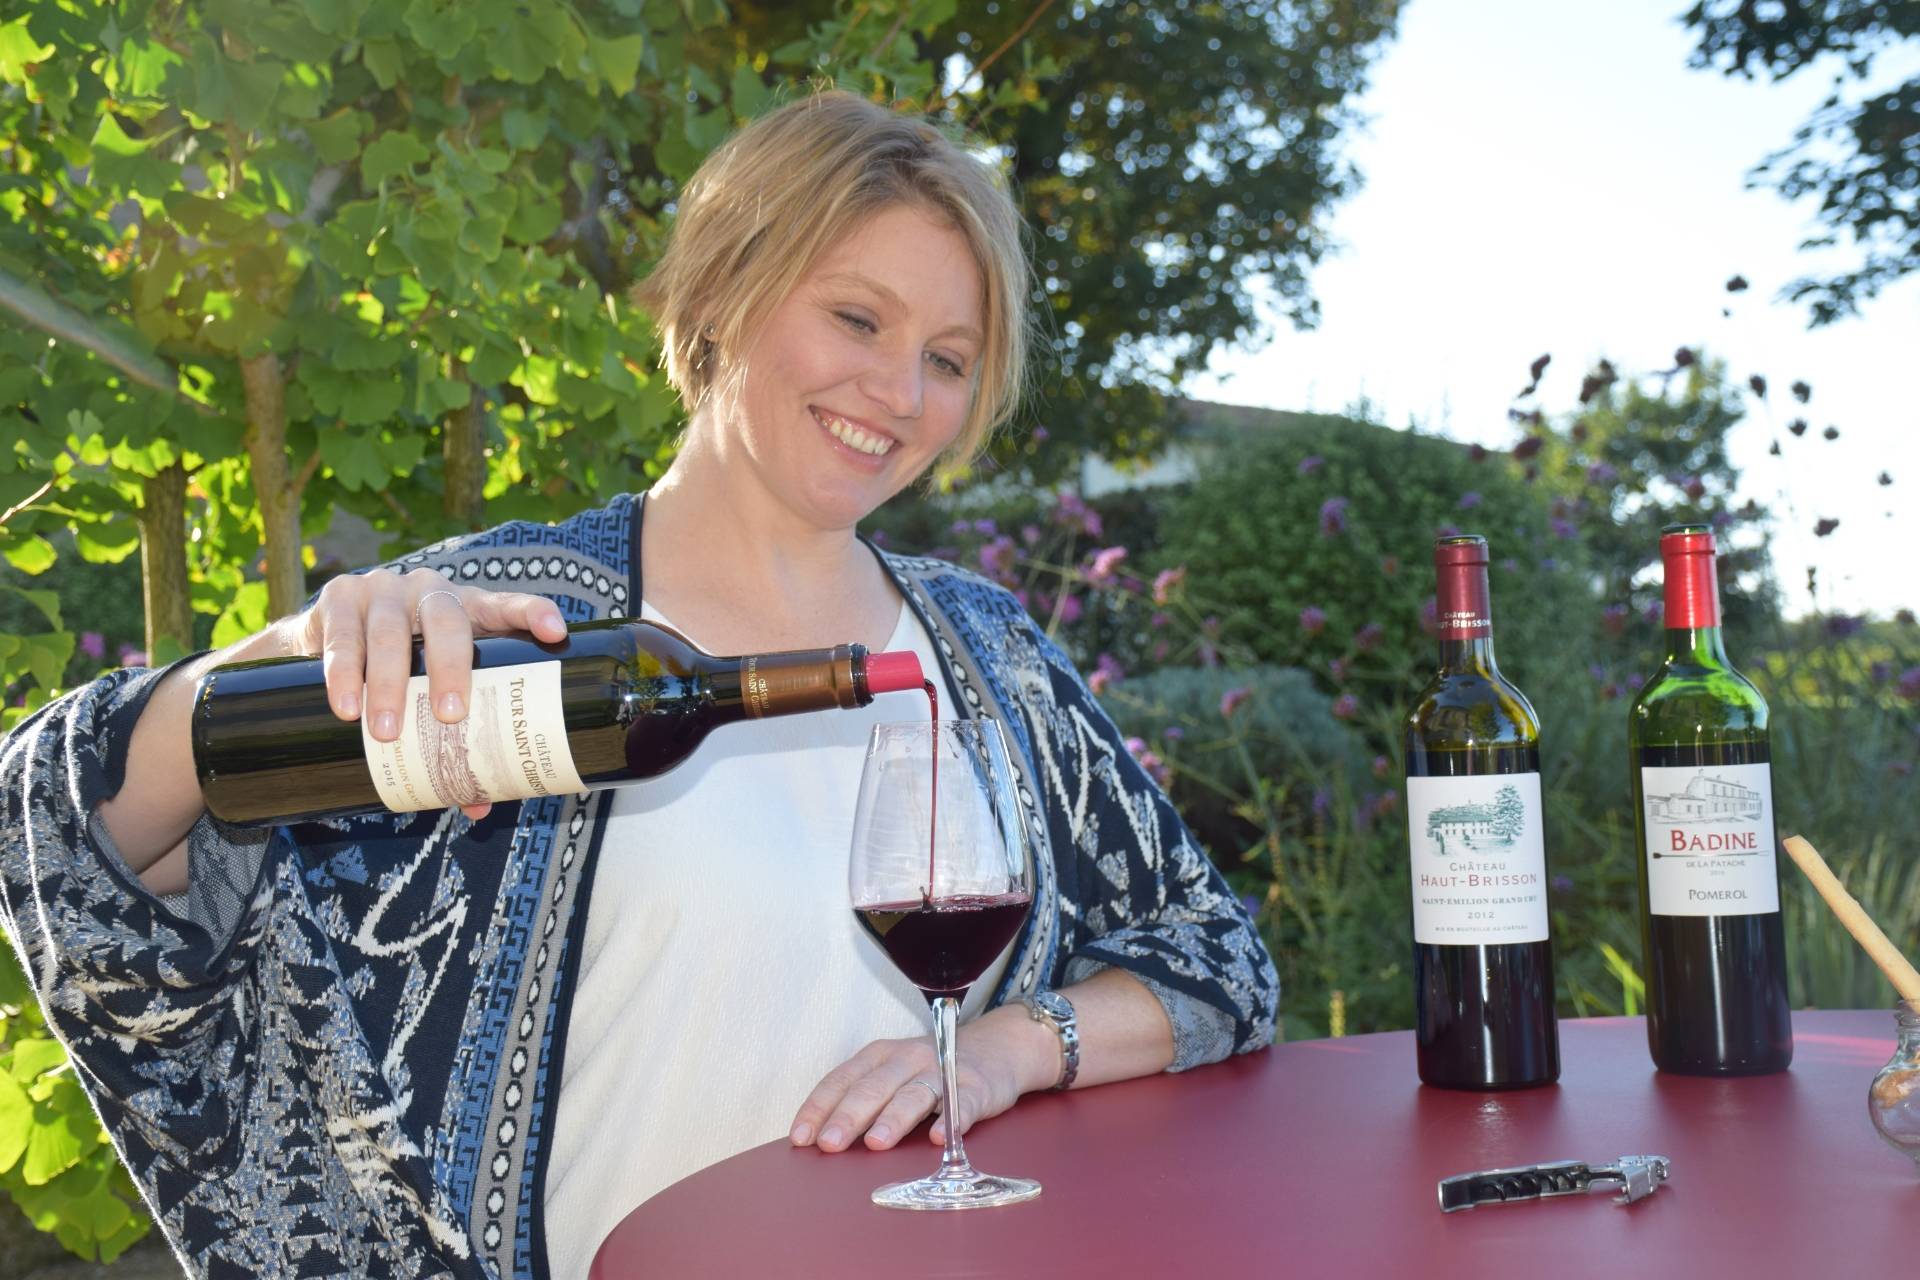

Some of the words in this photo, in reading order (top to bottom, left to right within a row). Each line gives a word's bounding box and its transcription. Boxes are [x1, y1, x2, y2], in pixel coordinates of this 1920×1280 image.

[510, 678, 525, 717] TOUR
[513, 719, 531, 758] SAINT
[534, 732, 557, 779] CHÂTEAU
[382, 762, 397, 787] 2015
[1670, 829, 1758, 851] BADINE
[1449, 861, 1505, 871] CHÂTEAU
[1697, 860, 1709, 868] LA
[1710, 860, 1745, 868] PATACHE
[1421, 873, 1536, 887] HAUT-BRISSON
[1492, 896, 1523, 905] GRAND
[1688, 889, 1748, 901] POMEROL
[1467, 911, 1495, 919] 2012
